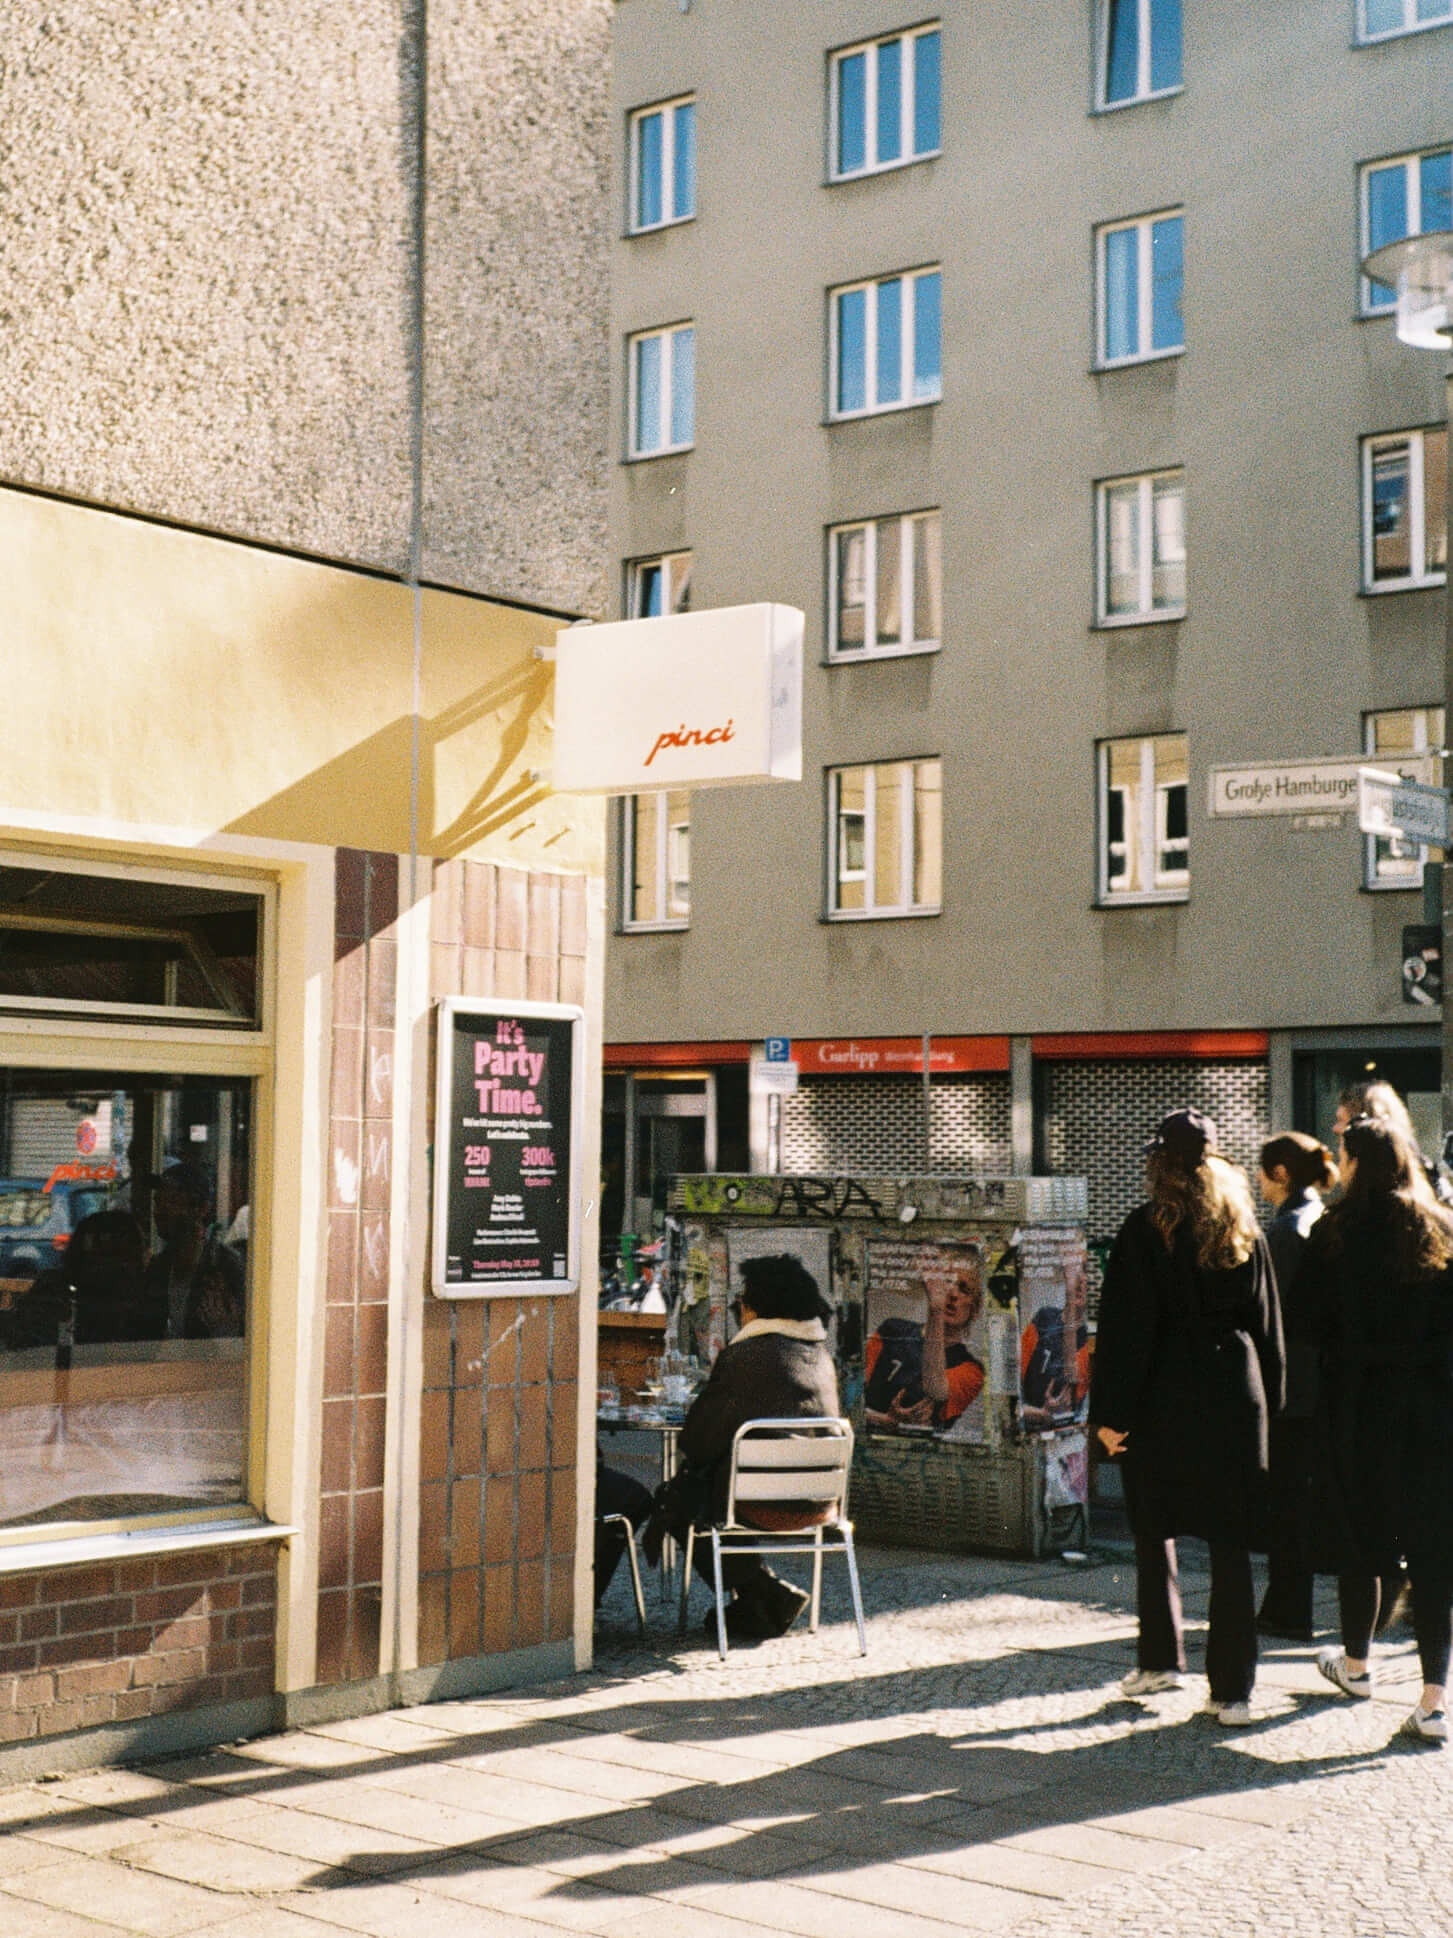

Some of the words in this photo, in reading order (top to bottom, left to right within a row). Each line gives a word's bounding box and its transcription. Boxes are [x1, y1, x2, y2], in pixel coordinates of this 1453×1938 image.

[643, 718, 736, 767] pinci
[1225, 779, 1273, 802] Große
[1275, 774, 1360, 799] Hamburge
[496, 1019, 525, 1046] It's
[474, 1040, 545, 1087] Party
[769, 1040, 783, 1059] P
[474, 1077, 543, 1116] Time.
[464, 1145, 491, 1167] 250
[521, 1147, 557, 1167] 300k
[42, 1157, 119, 1194] pinci
